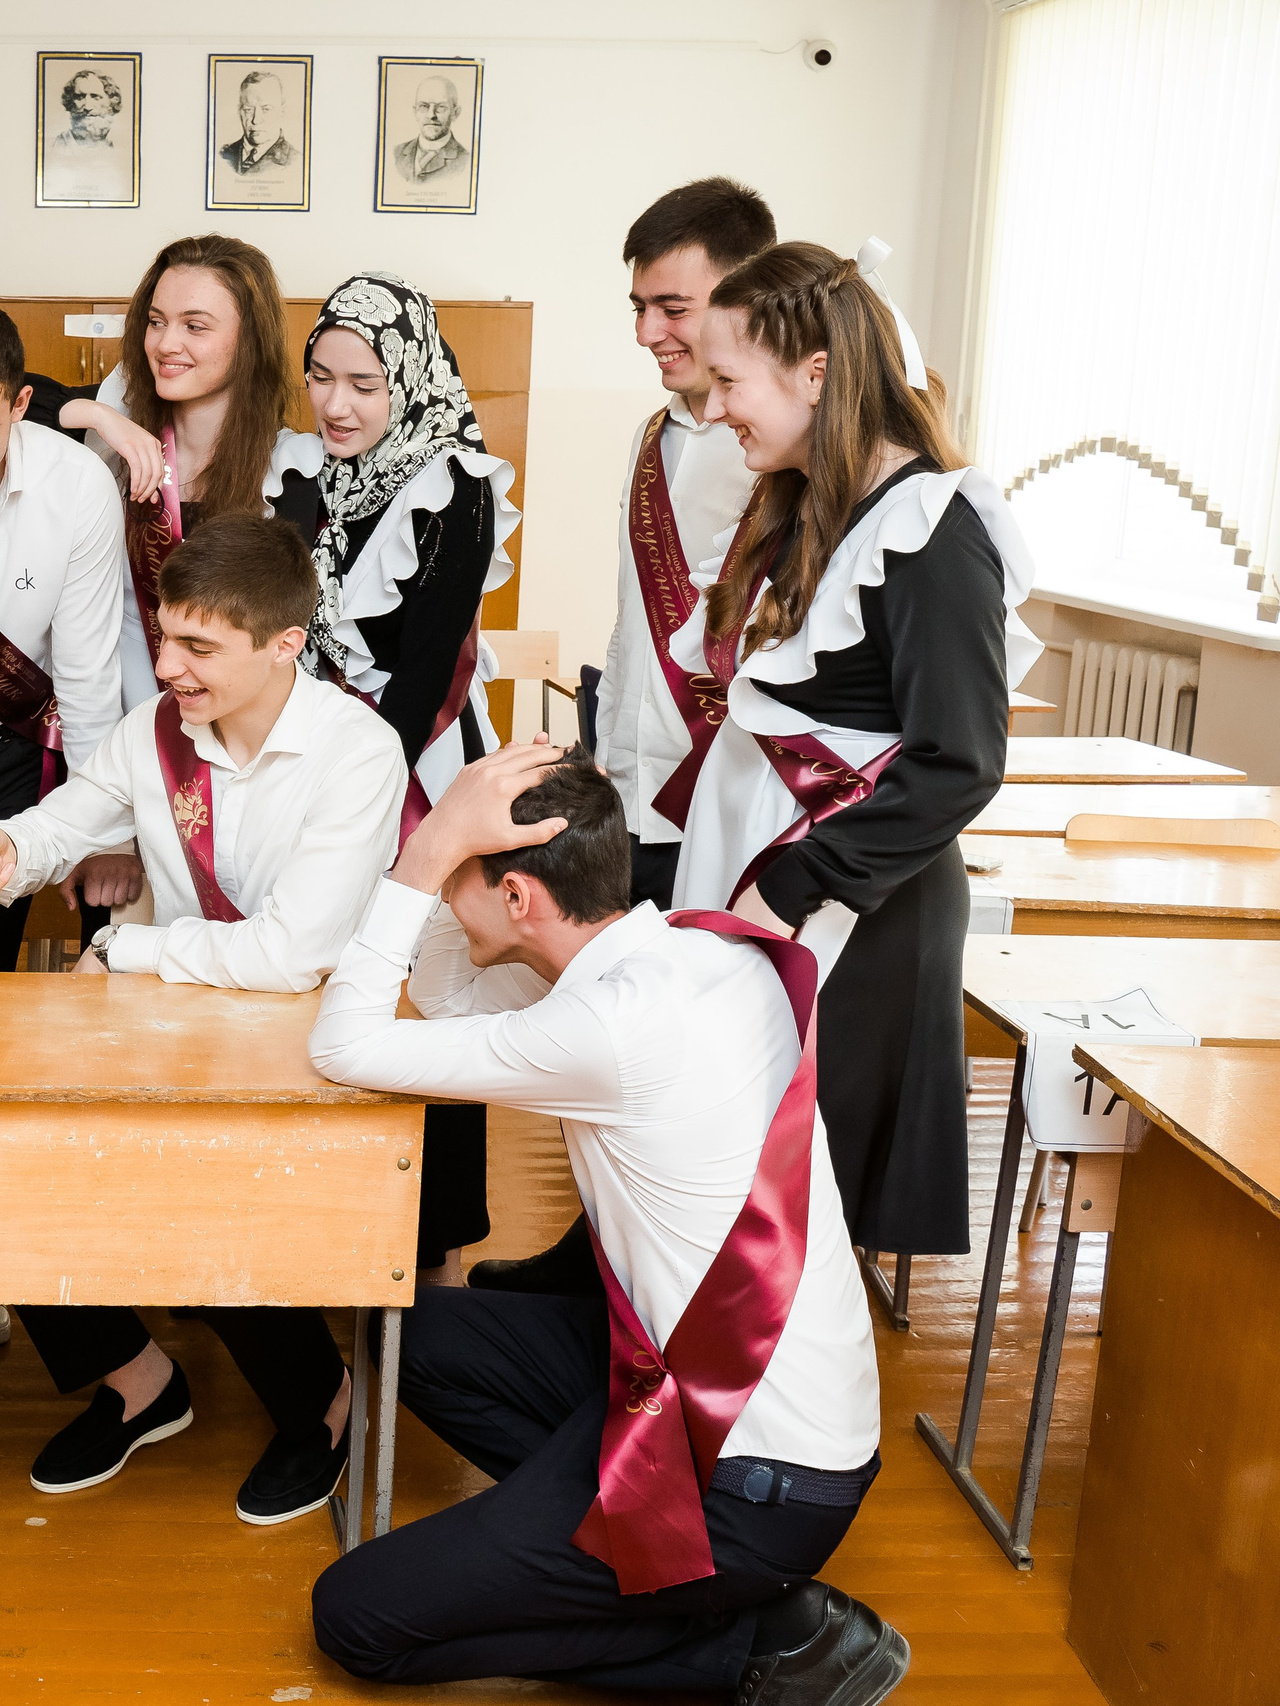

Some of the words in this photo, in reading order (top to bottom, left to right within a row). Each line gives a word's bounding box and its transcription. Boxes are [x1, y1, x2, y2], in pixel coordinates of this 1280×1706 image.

[635, 446, 681, 629] Выпускник
[662, 511, 682, 573] Герейханов
[680, 572, 697, 610] Рамаз
